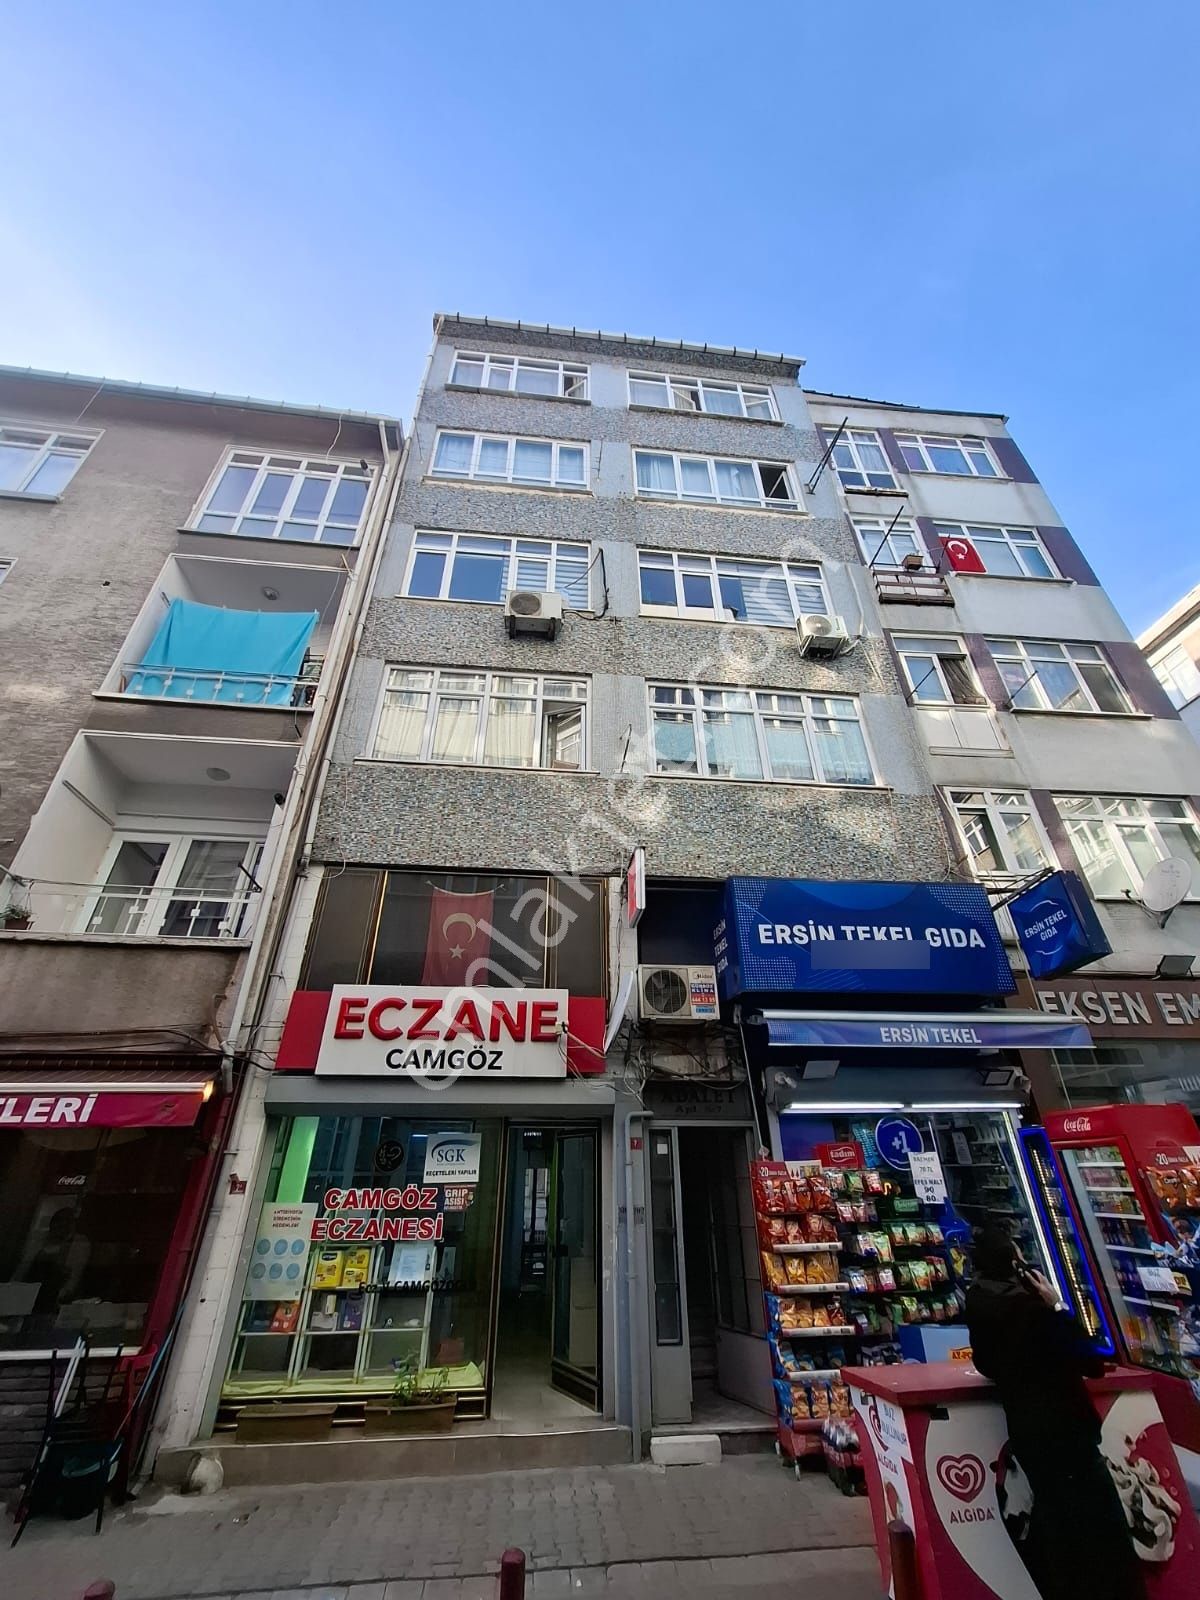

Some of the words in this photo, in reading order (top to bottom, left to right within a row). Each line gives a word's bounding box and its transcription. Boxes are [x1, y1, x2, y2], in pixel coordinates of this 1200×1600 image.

[758, 920, 836, 945] ERSİN
[925, 927, 986, 948] GIDA
[1024, 918, 1046, 939] ERSİN
[1043, 909, 1068, 929] TEKEL
[1040, 926, 1059, 941] GIDA
[333, 997, 559, 1042] ECZANE
[1036, 991, 1153, 1024] EKSEN
[879, 1024, 929, 1043] ERSİN
[930, 1028, 982, 1043] TEKEL
[385, 1045, 504, 1071] CAMGÖZ
[0, 1093, 99, 1123] LERİ
[1063, 1116, 1092, 1133] Coca-Cola
[436, 1148, 466, 1163] SGK
[323, 1184, 438, 1211] CAMGÖZ
[923, 1186, 935, 1194] 90
[310, 1212, 444, 1241] ECZANESİ
